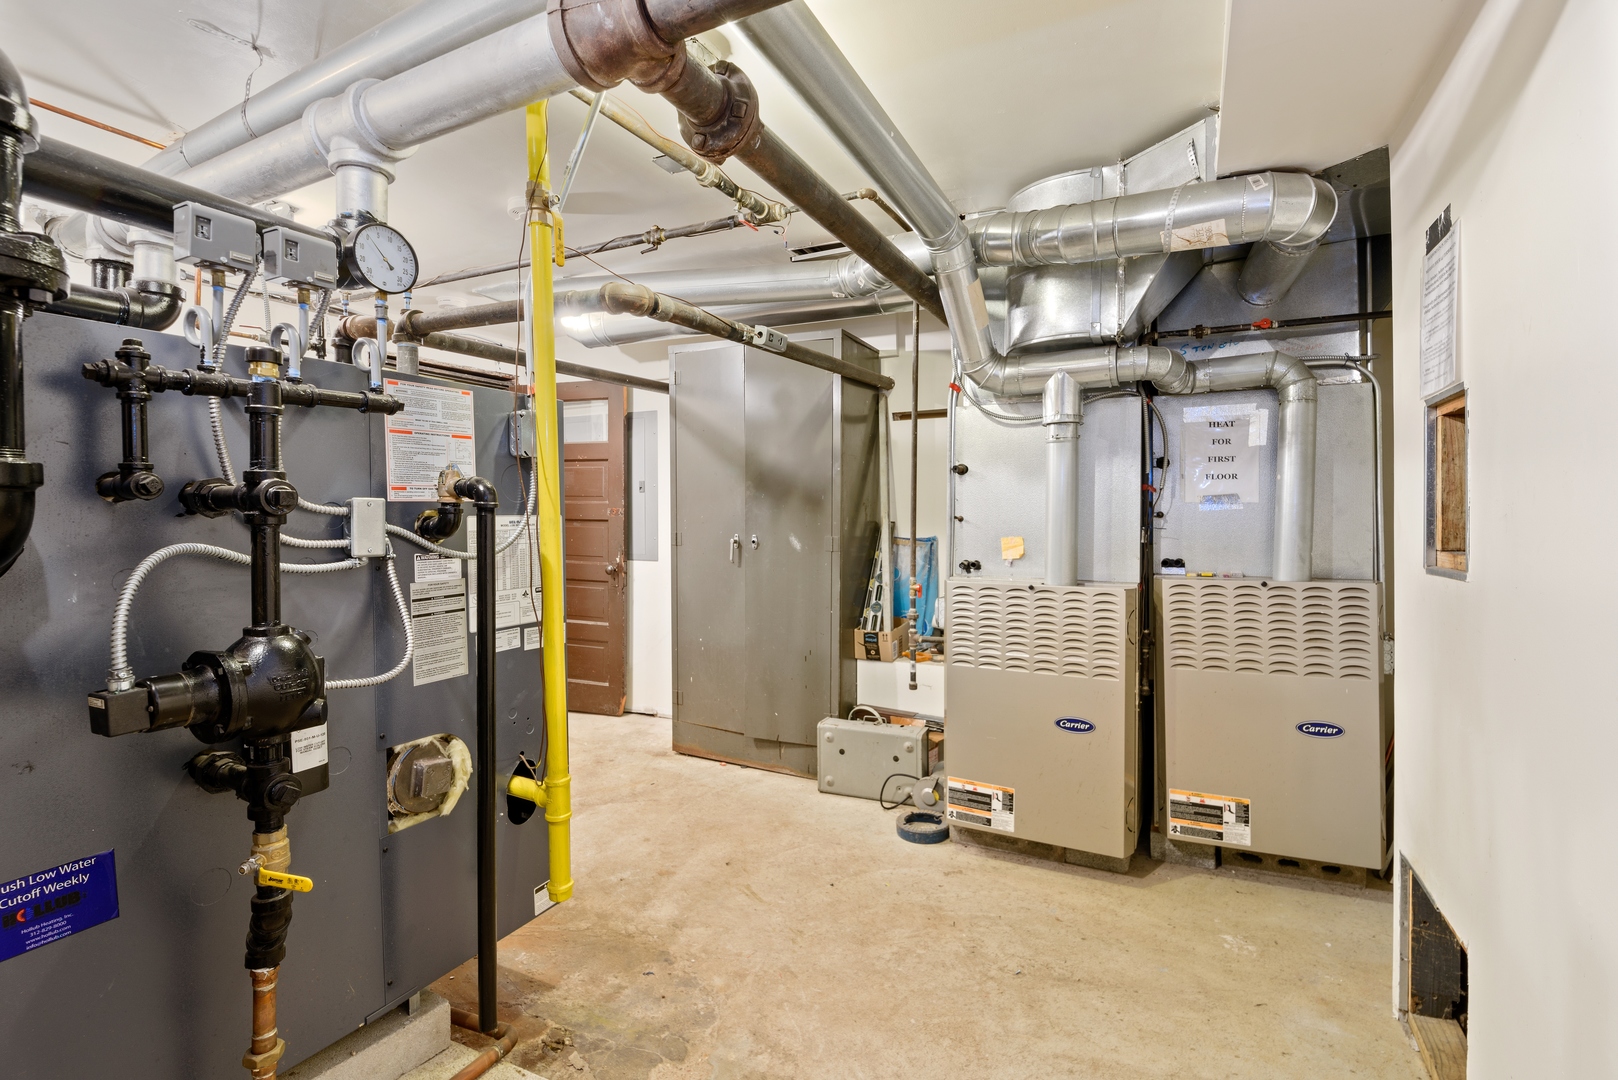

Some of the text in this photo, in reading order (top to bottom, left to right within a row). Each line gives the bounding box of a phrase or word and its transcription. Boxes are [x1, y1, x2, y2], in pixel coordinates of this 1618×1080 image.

[359, 255, 366, 263] 20
[403, 268, 409, 276] 25
[1208, 420, 1236, 429] HEAT
[1211, 438, 1232, 446] FOR
[1059, 719, 1090, 730] Carrier
[1302, 724, 1338, 734] Carrier
[0, 857, 97, 894] ush Low Water
[0, 873, 90, 909] Cutoff Weekly
[20, 924, 41, 935] Hollub
[25, 925, 72, 945] www.hollub.com
[25, 930, 72, 950] info@hollub.com
